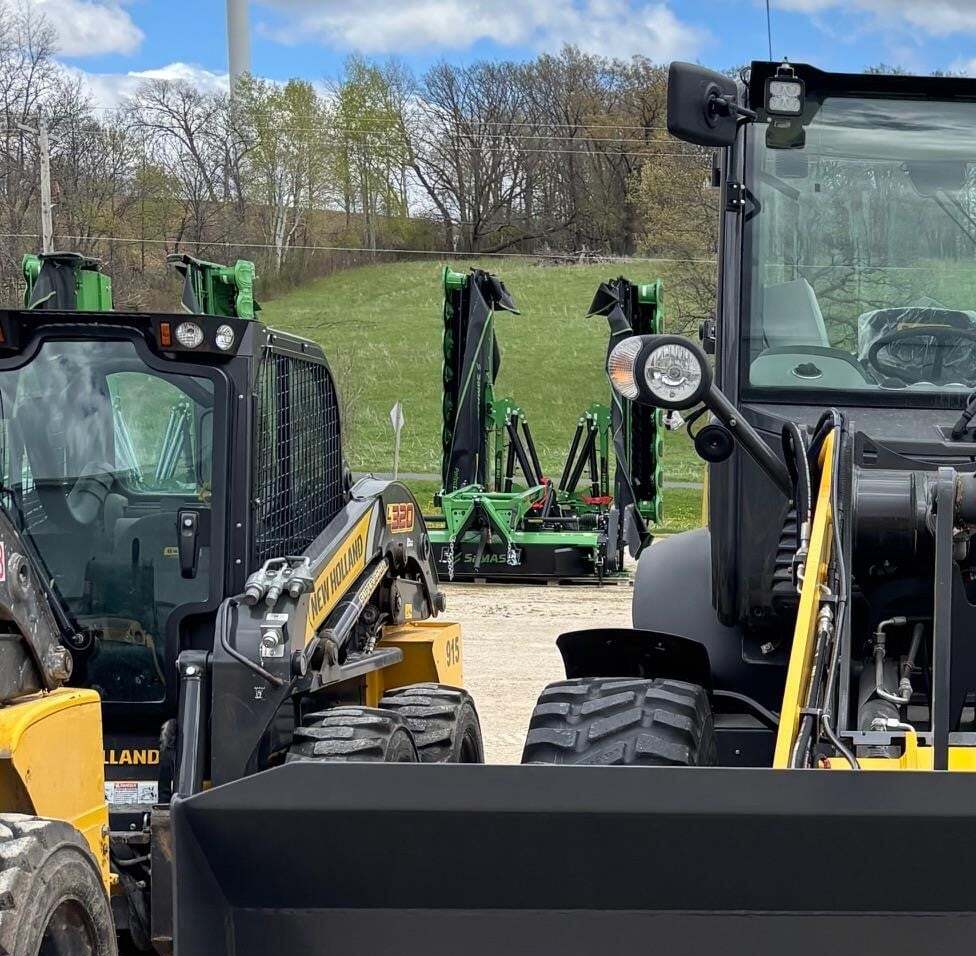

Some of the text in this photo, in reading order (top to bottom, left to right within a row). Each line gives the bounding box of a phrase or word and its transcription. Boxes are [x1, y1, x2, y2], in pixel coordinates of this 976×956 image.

[310, 534, 364, 618] NEW HOLLAND
[446, 637, 460, 667] 915
